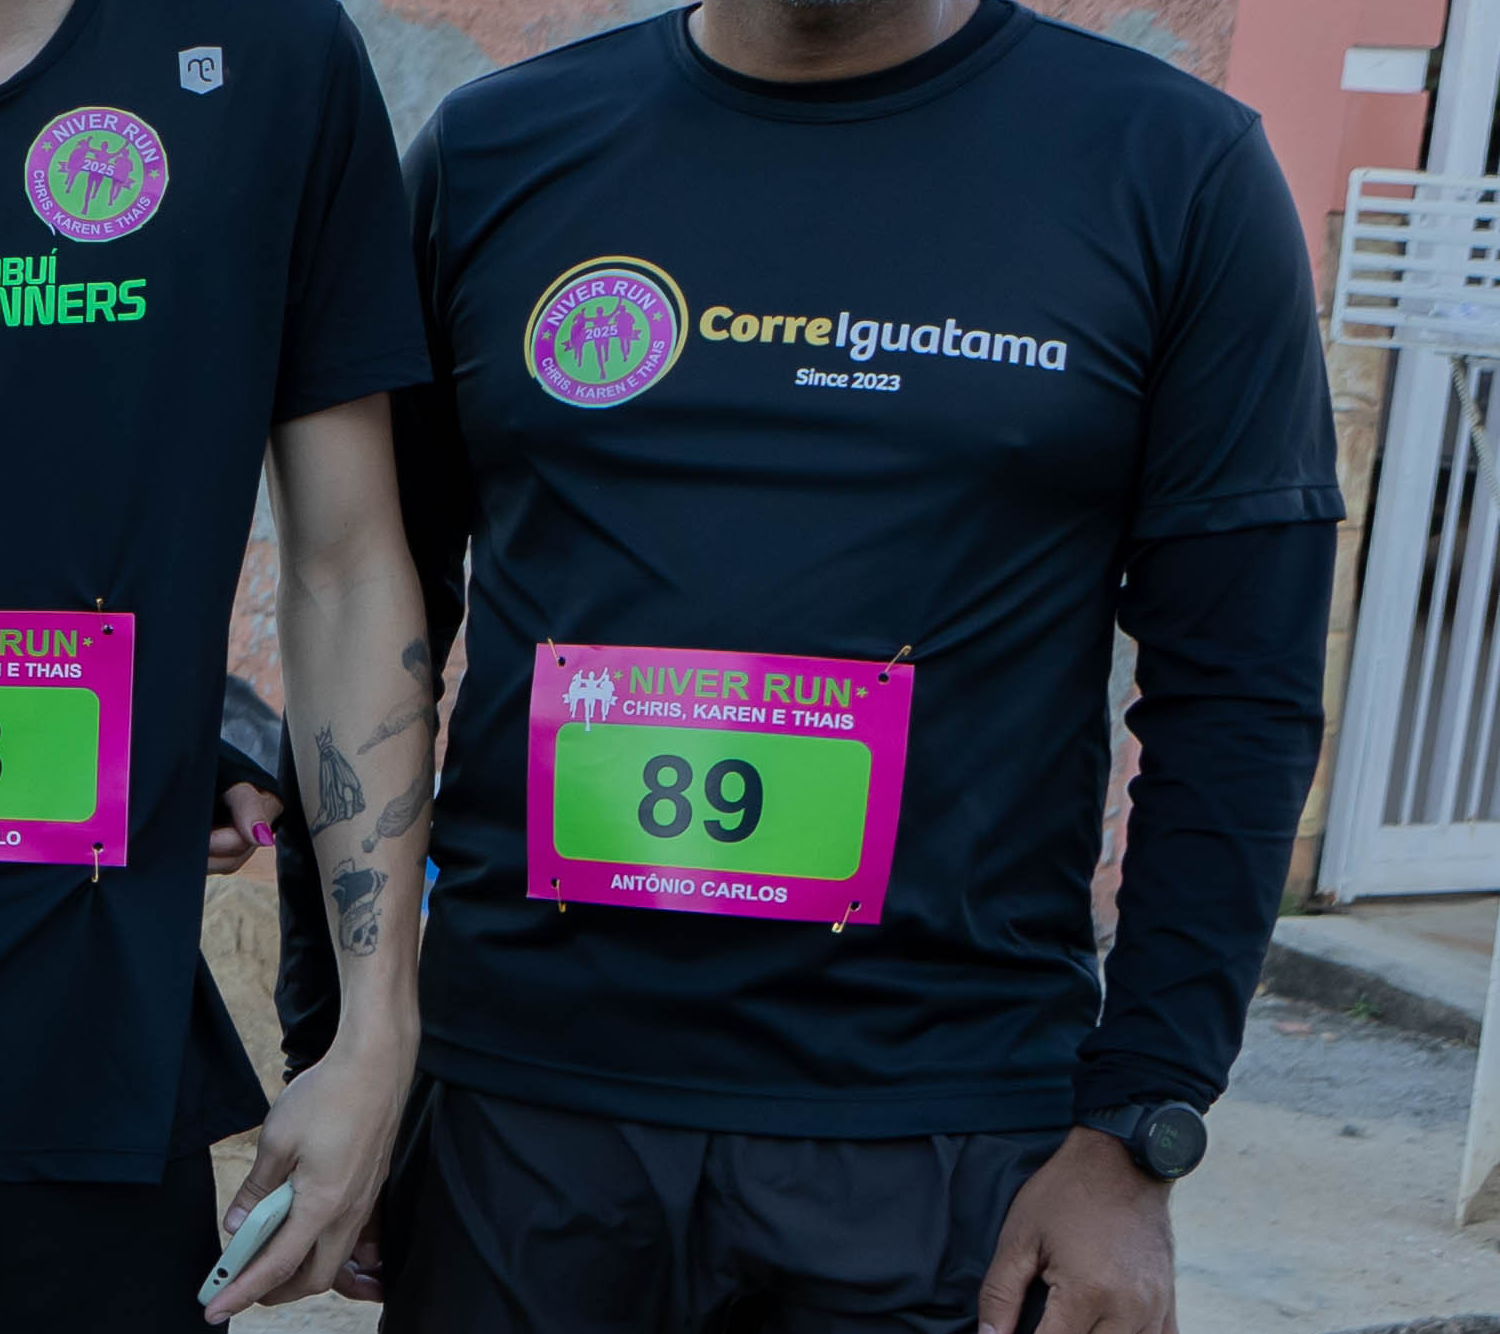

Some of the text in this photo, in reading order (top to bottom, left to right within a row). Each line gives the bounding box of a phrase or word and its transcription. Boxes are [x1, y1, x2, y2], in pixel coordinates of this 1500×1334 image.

[52, 114, 159, 164] NIVER RUN
[82, 160, 115, 176] 2025
[53, 212, 101, 235] KAREN
[104, 223, 114, 233] E
[116, 196, 151, 229] THAIS
[548, 280, 657, 326] NIVER RUN
[585, 325, 618, 339] 2025
[576, 383, 626, 399] KAREN
[627, 376, 639, 387] E
[636, 340, 665, 378] THAIS
[795, 368, 901, 392] Since 2023
[0, 630, 78, 657] RUN
[8, 663, 20, 678] E
[25, 662, 82, 679] THAIS
[630, 666, 851, 707] NIVER RUN
[623, 700, 854, 730] CHRIS, KAREN E THAIS
[638, 754, 763, 844] 89
[611, 873, 788, 903] ANTÔNIO CARLOS
